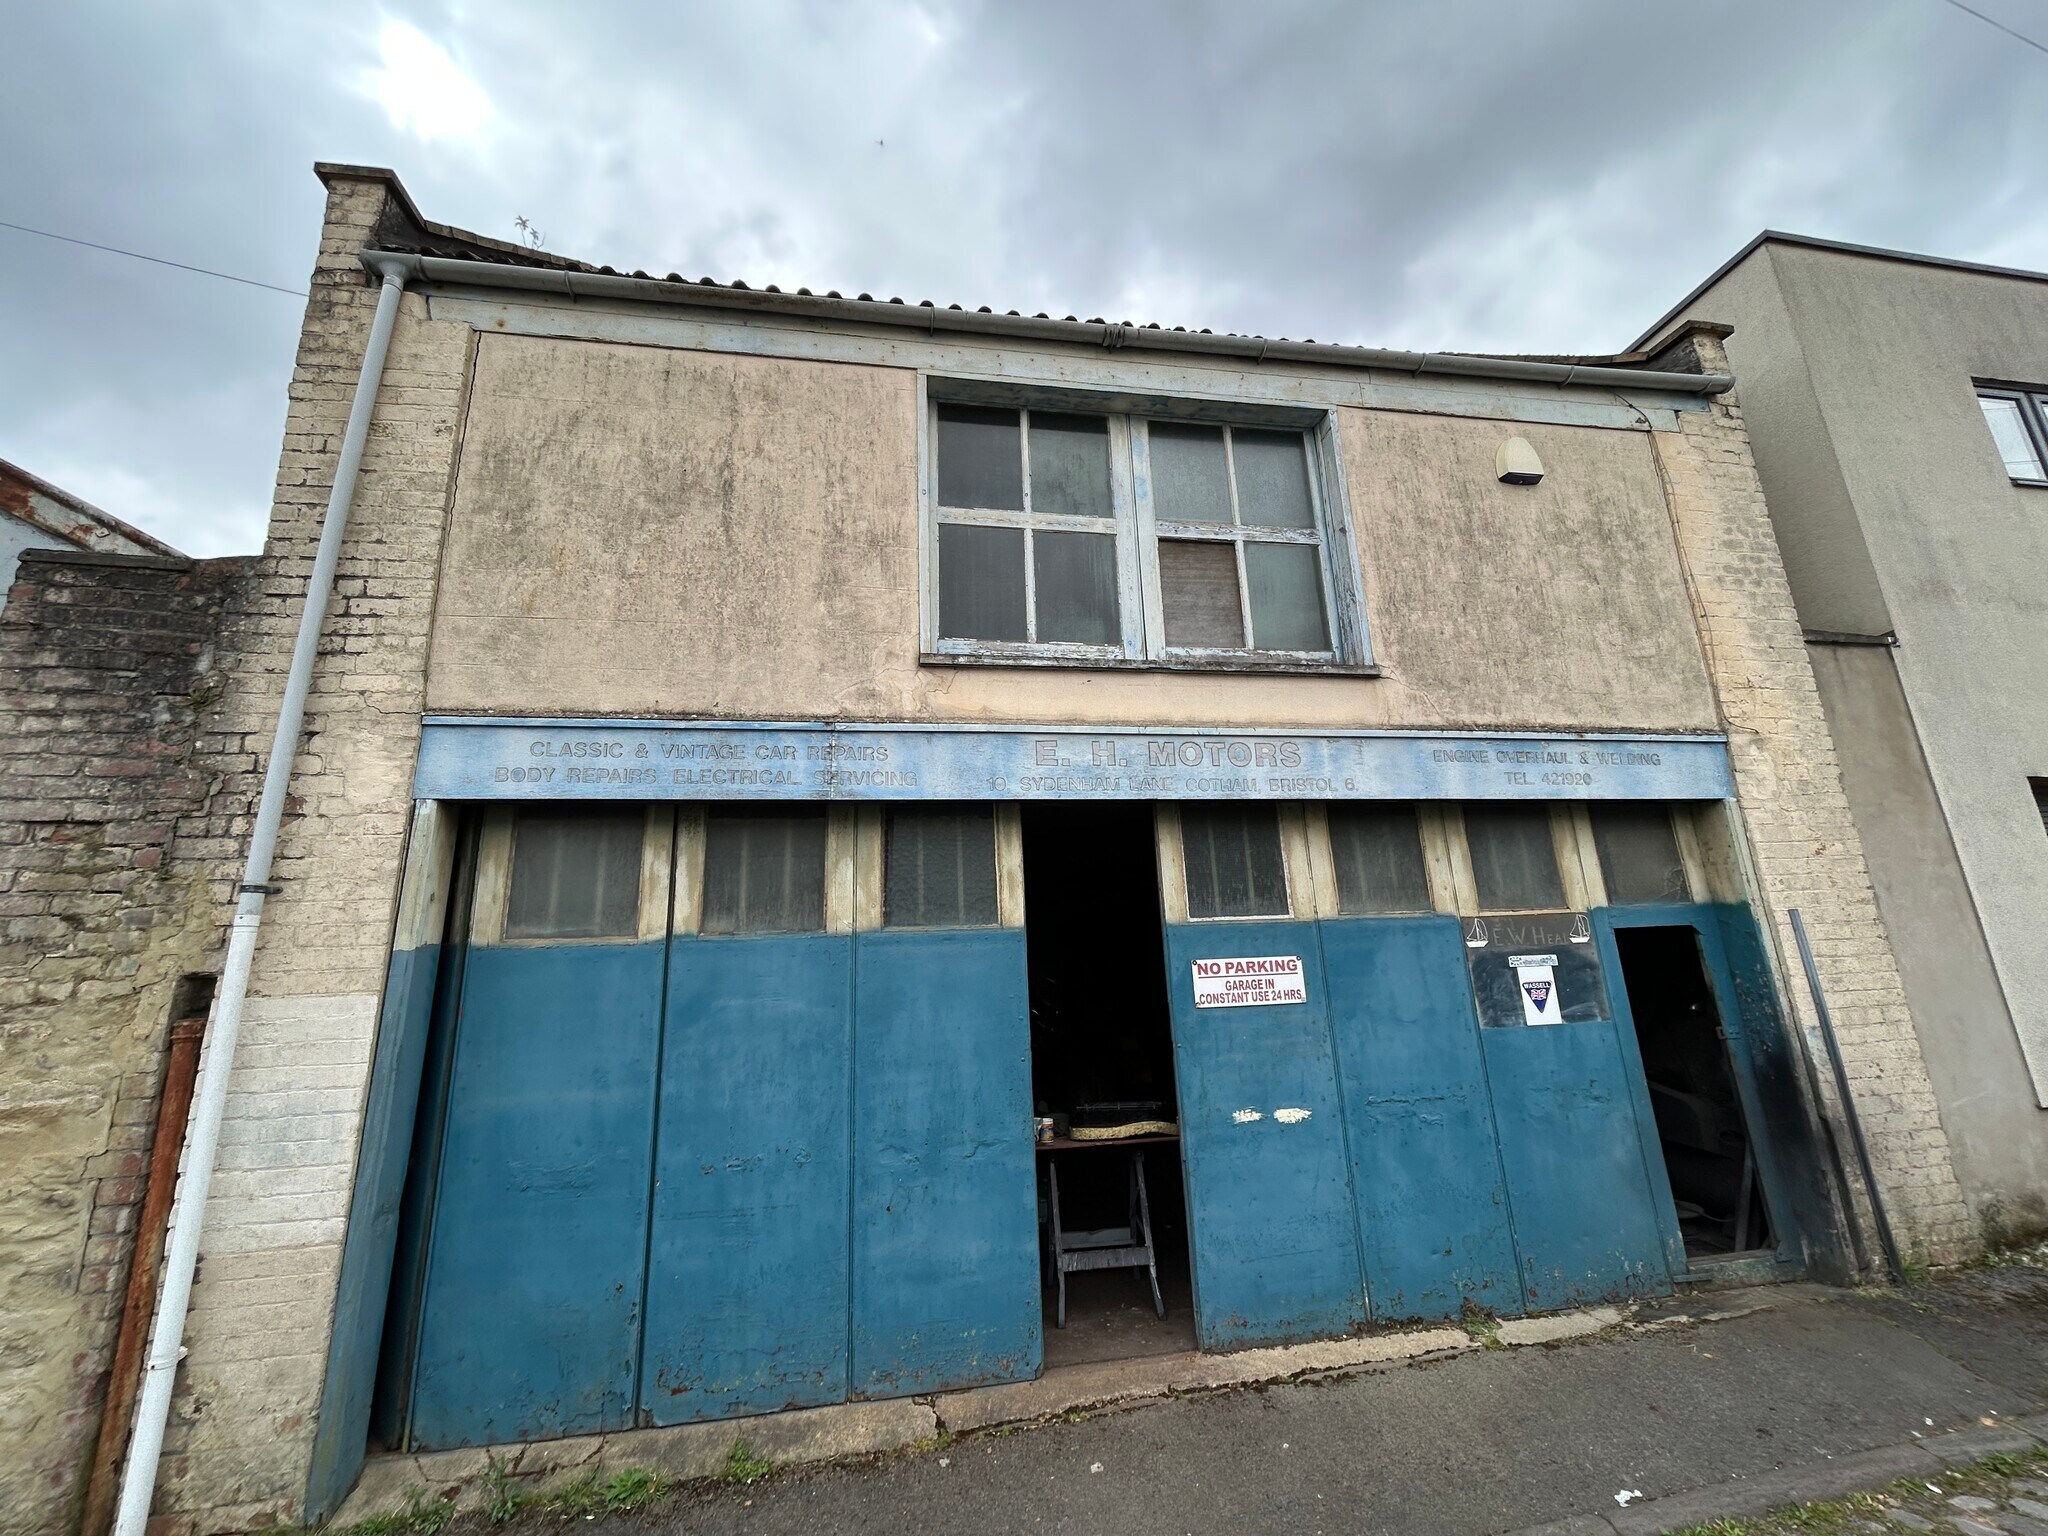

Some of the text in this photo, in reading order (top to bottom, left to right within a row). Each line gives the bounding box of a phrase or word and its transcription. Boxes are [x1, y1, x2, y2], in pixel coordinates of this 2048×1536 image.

[530, 741, 889, 761] CLASSIC & VINTAGE CAR REPAIRS
[1035, 740, 1301, 767] E. H. MOTORS
[1433, 749, 1661, 766] ENGINE OVERHAUL & WELDING
[494, 767, 556, 782] BODY
[566, 768, 657, 784] REPAIRS
[813, 770, 918, 787] SERVICING
[1020, 776, 1120, 792] SYDENHAM
[1541, 772, 1593, 786] 421920
[1197, 959, 1298, 976] NO PARKING
[1225, 979, 1275, 991] GARAGE IN
[1199, 989, 1302, 1005] CONSTANT USE 24 HRS
